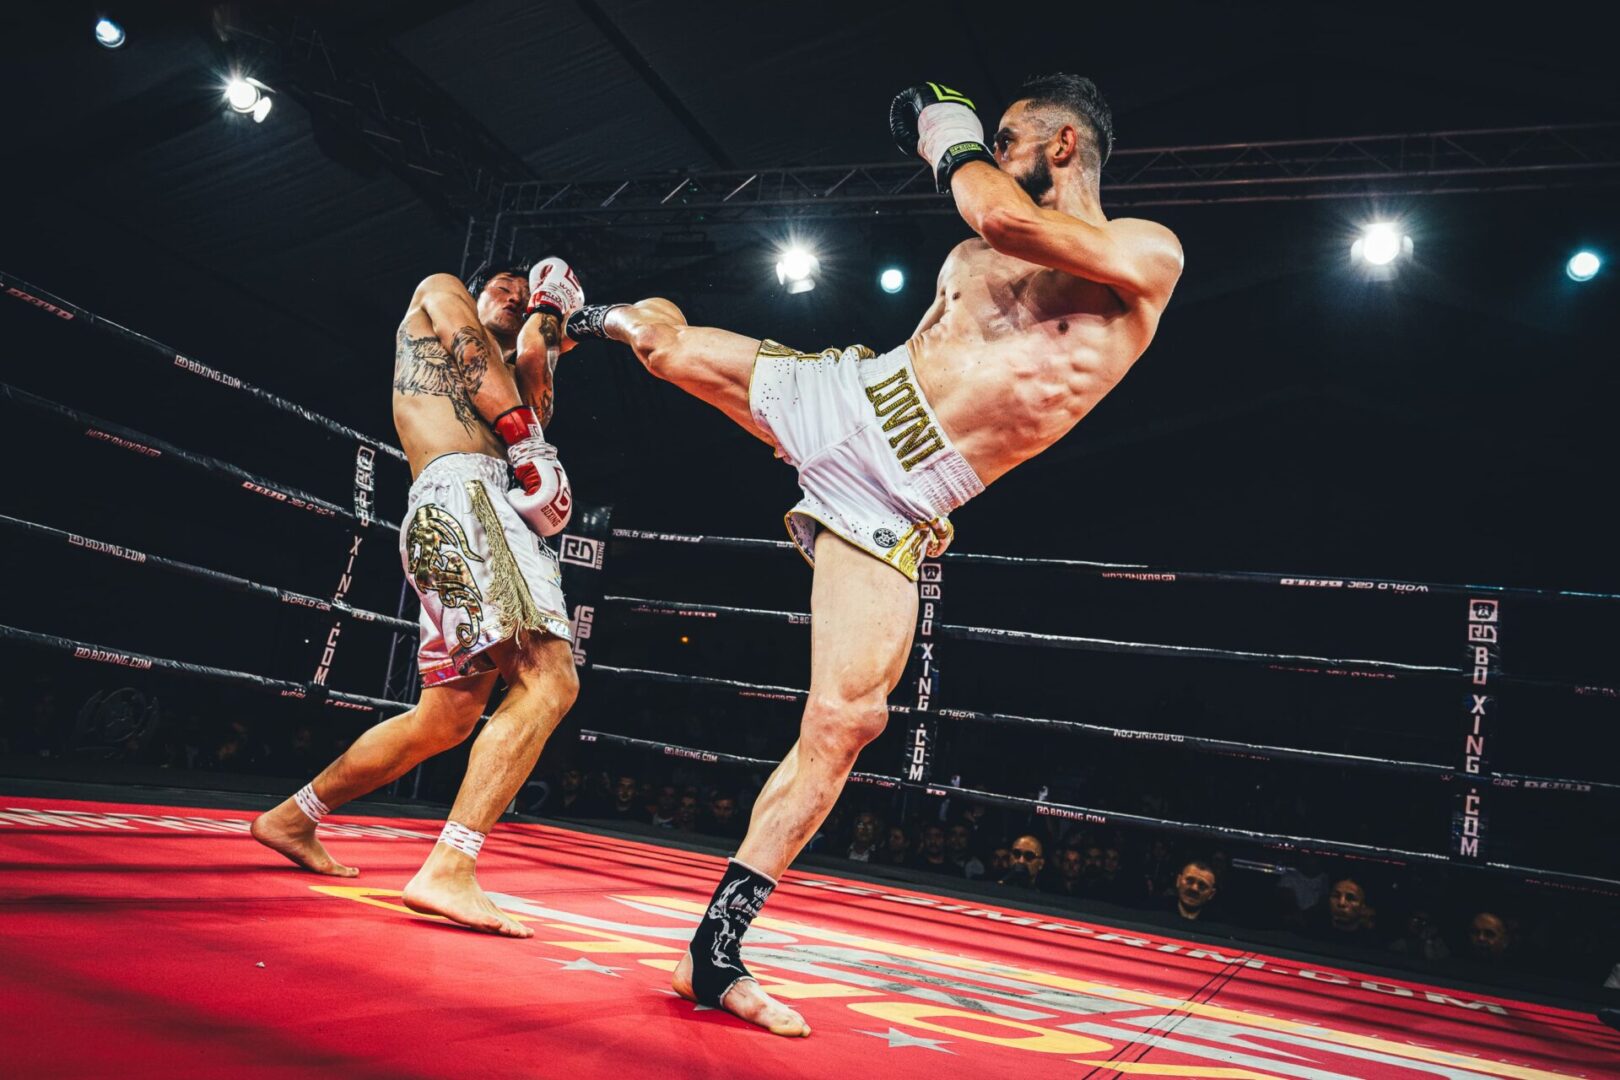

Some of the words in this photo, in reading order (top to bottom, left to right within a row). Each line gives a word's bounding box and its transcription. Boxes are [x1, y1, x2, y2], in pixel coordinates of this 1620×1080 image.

[540, 504, 562, 528] BOXING
[1377, 582, 1429, 593] WORLD
[281, 593, 315, 609] WORLD
[939, 708, 976, 720] WORLD
